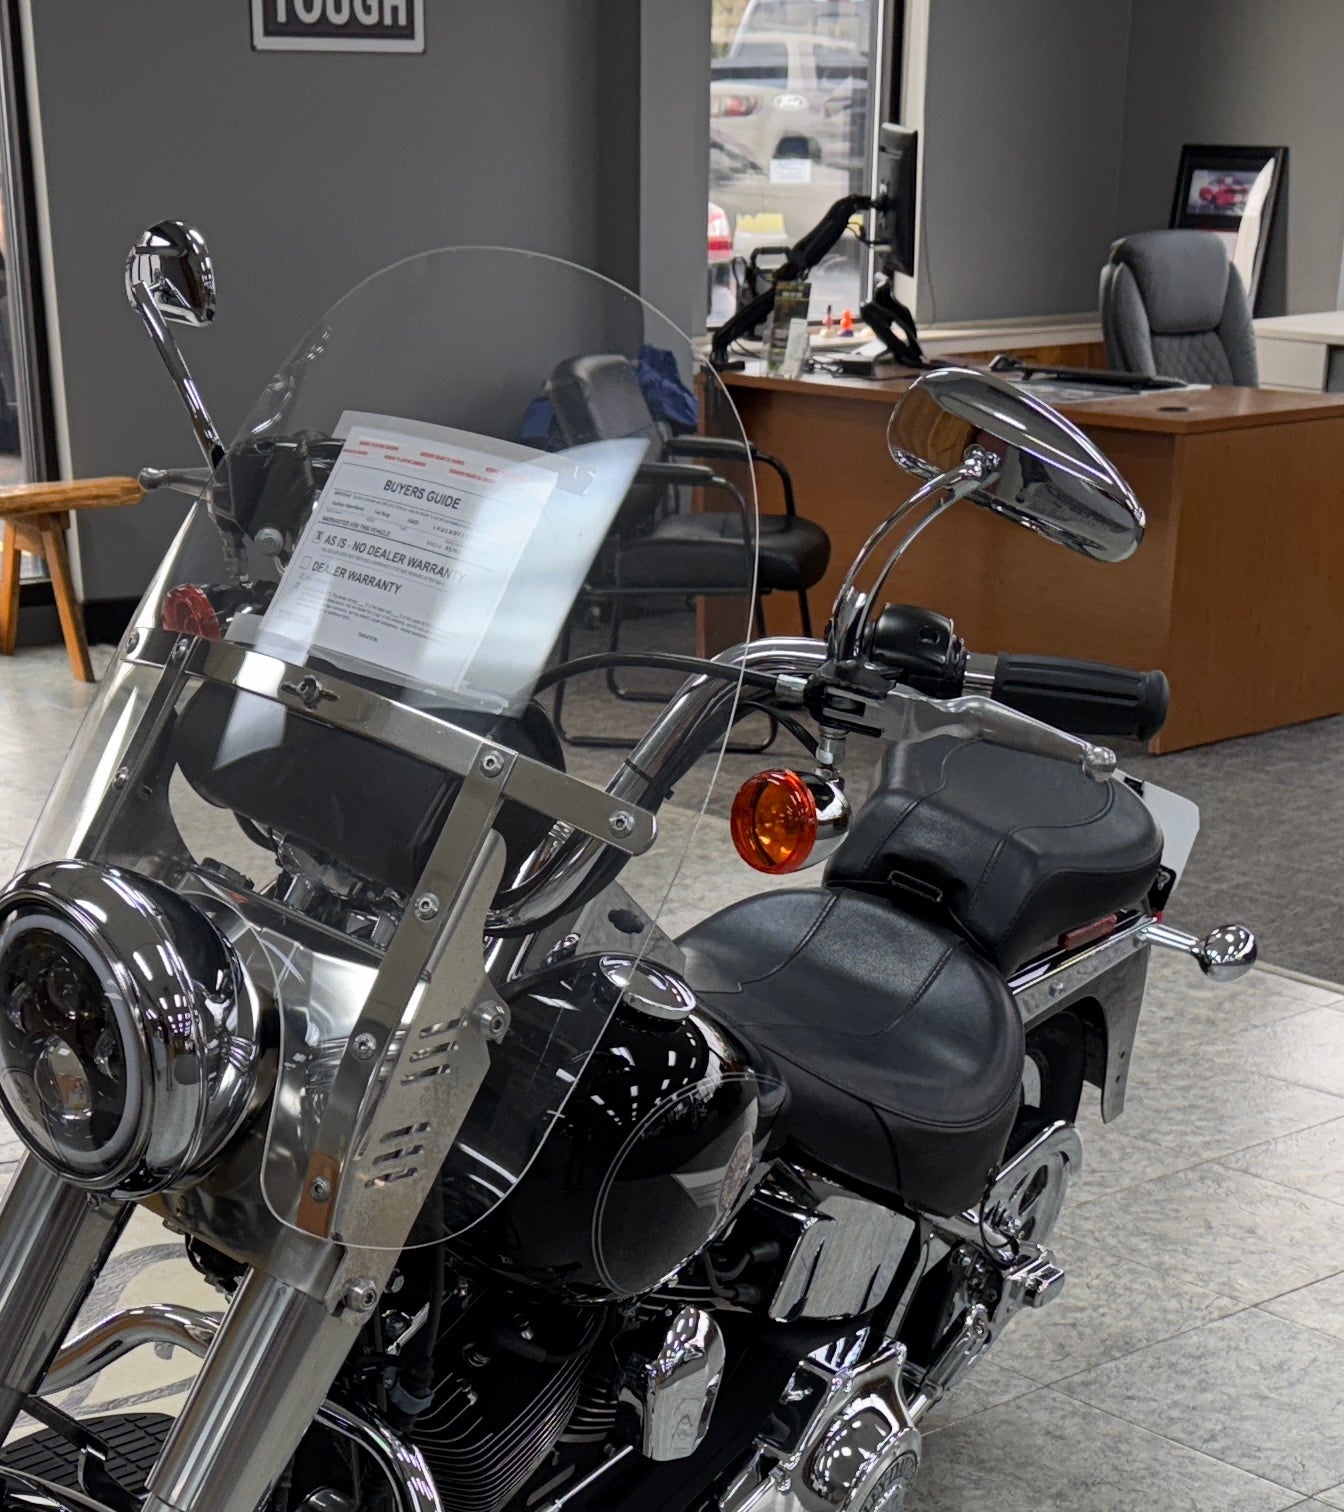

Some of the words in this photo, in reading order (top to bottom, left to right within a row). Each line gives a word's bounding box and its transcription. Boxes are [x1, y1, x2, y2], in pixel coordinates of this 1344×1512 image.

[383, 479, 426, 500] BUYERS
[426, 490, 462, 510] GUIDE
[324, 534, 338, 547] AS
[336, 537, 348, 549] IS
[351, 541, 367, 554] NO
[367, 544, 407, 565] DEALER
[406, 556, 467, 583] WARRANTY
[311, 560, 348, 580] DEALER
[346, 569, 403, 595] WARRANTY
